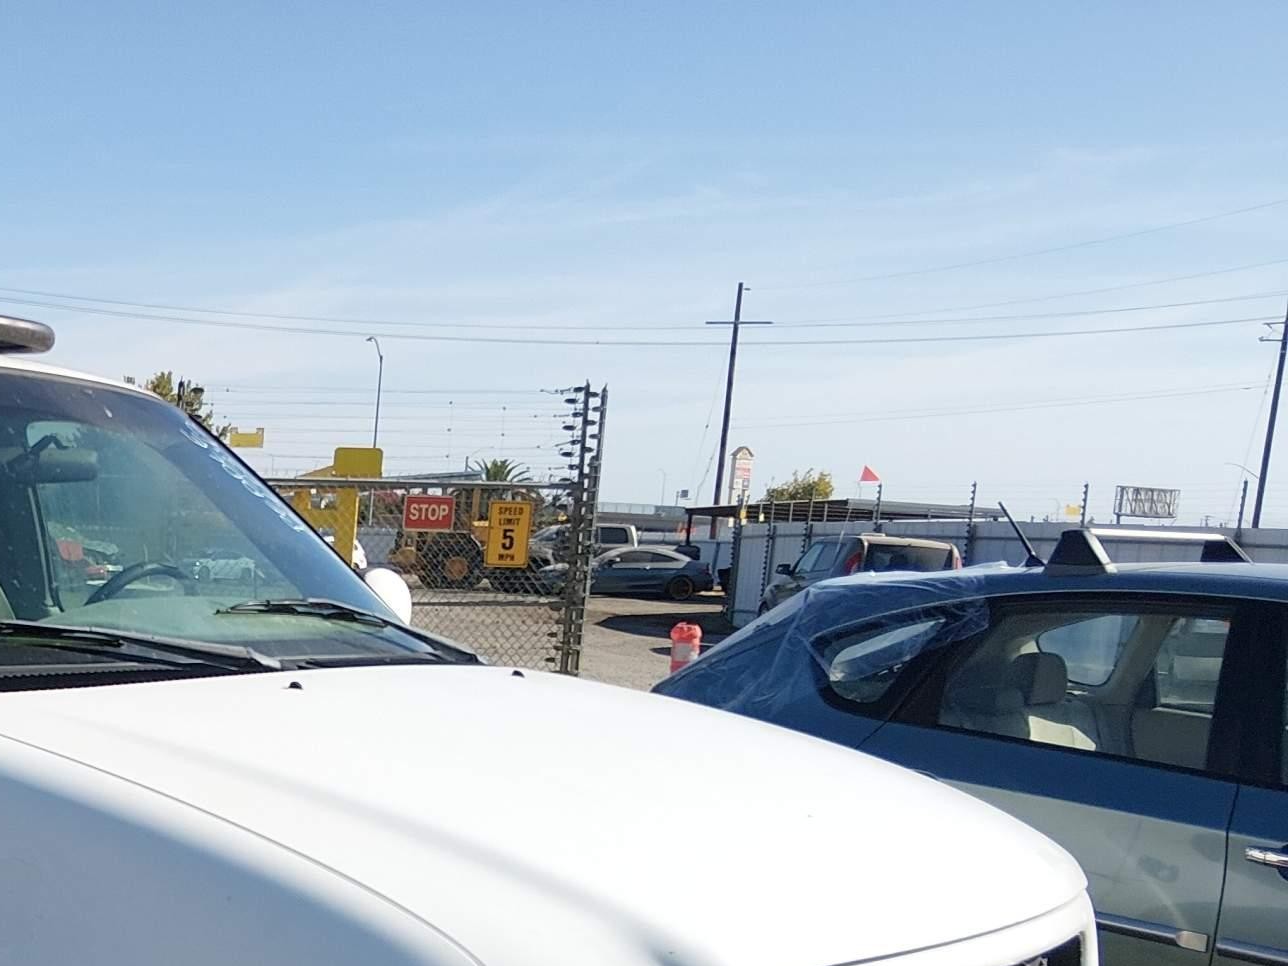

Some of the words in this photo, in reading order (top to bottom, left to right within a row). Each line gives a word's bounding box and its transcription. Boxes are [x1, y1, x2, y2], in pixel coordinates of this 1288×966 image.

[409, 503, 449, 521] STOP
[498, 506, 524, 516] SPEED
[499, 518, 520, 526] LIMIT
[501, 529, 514, 550] 5
[498, 554, 515, 562] MPH
